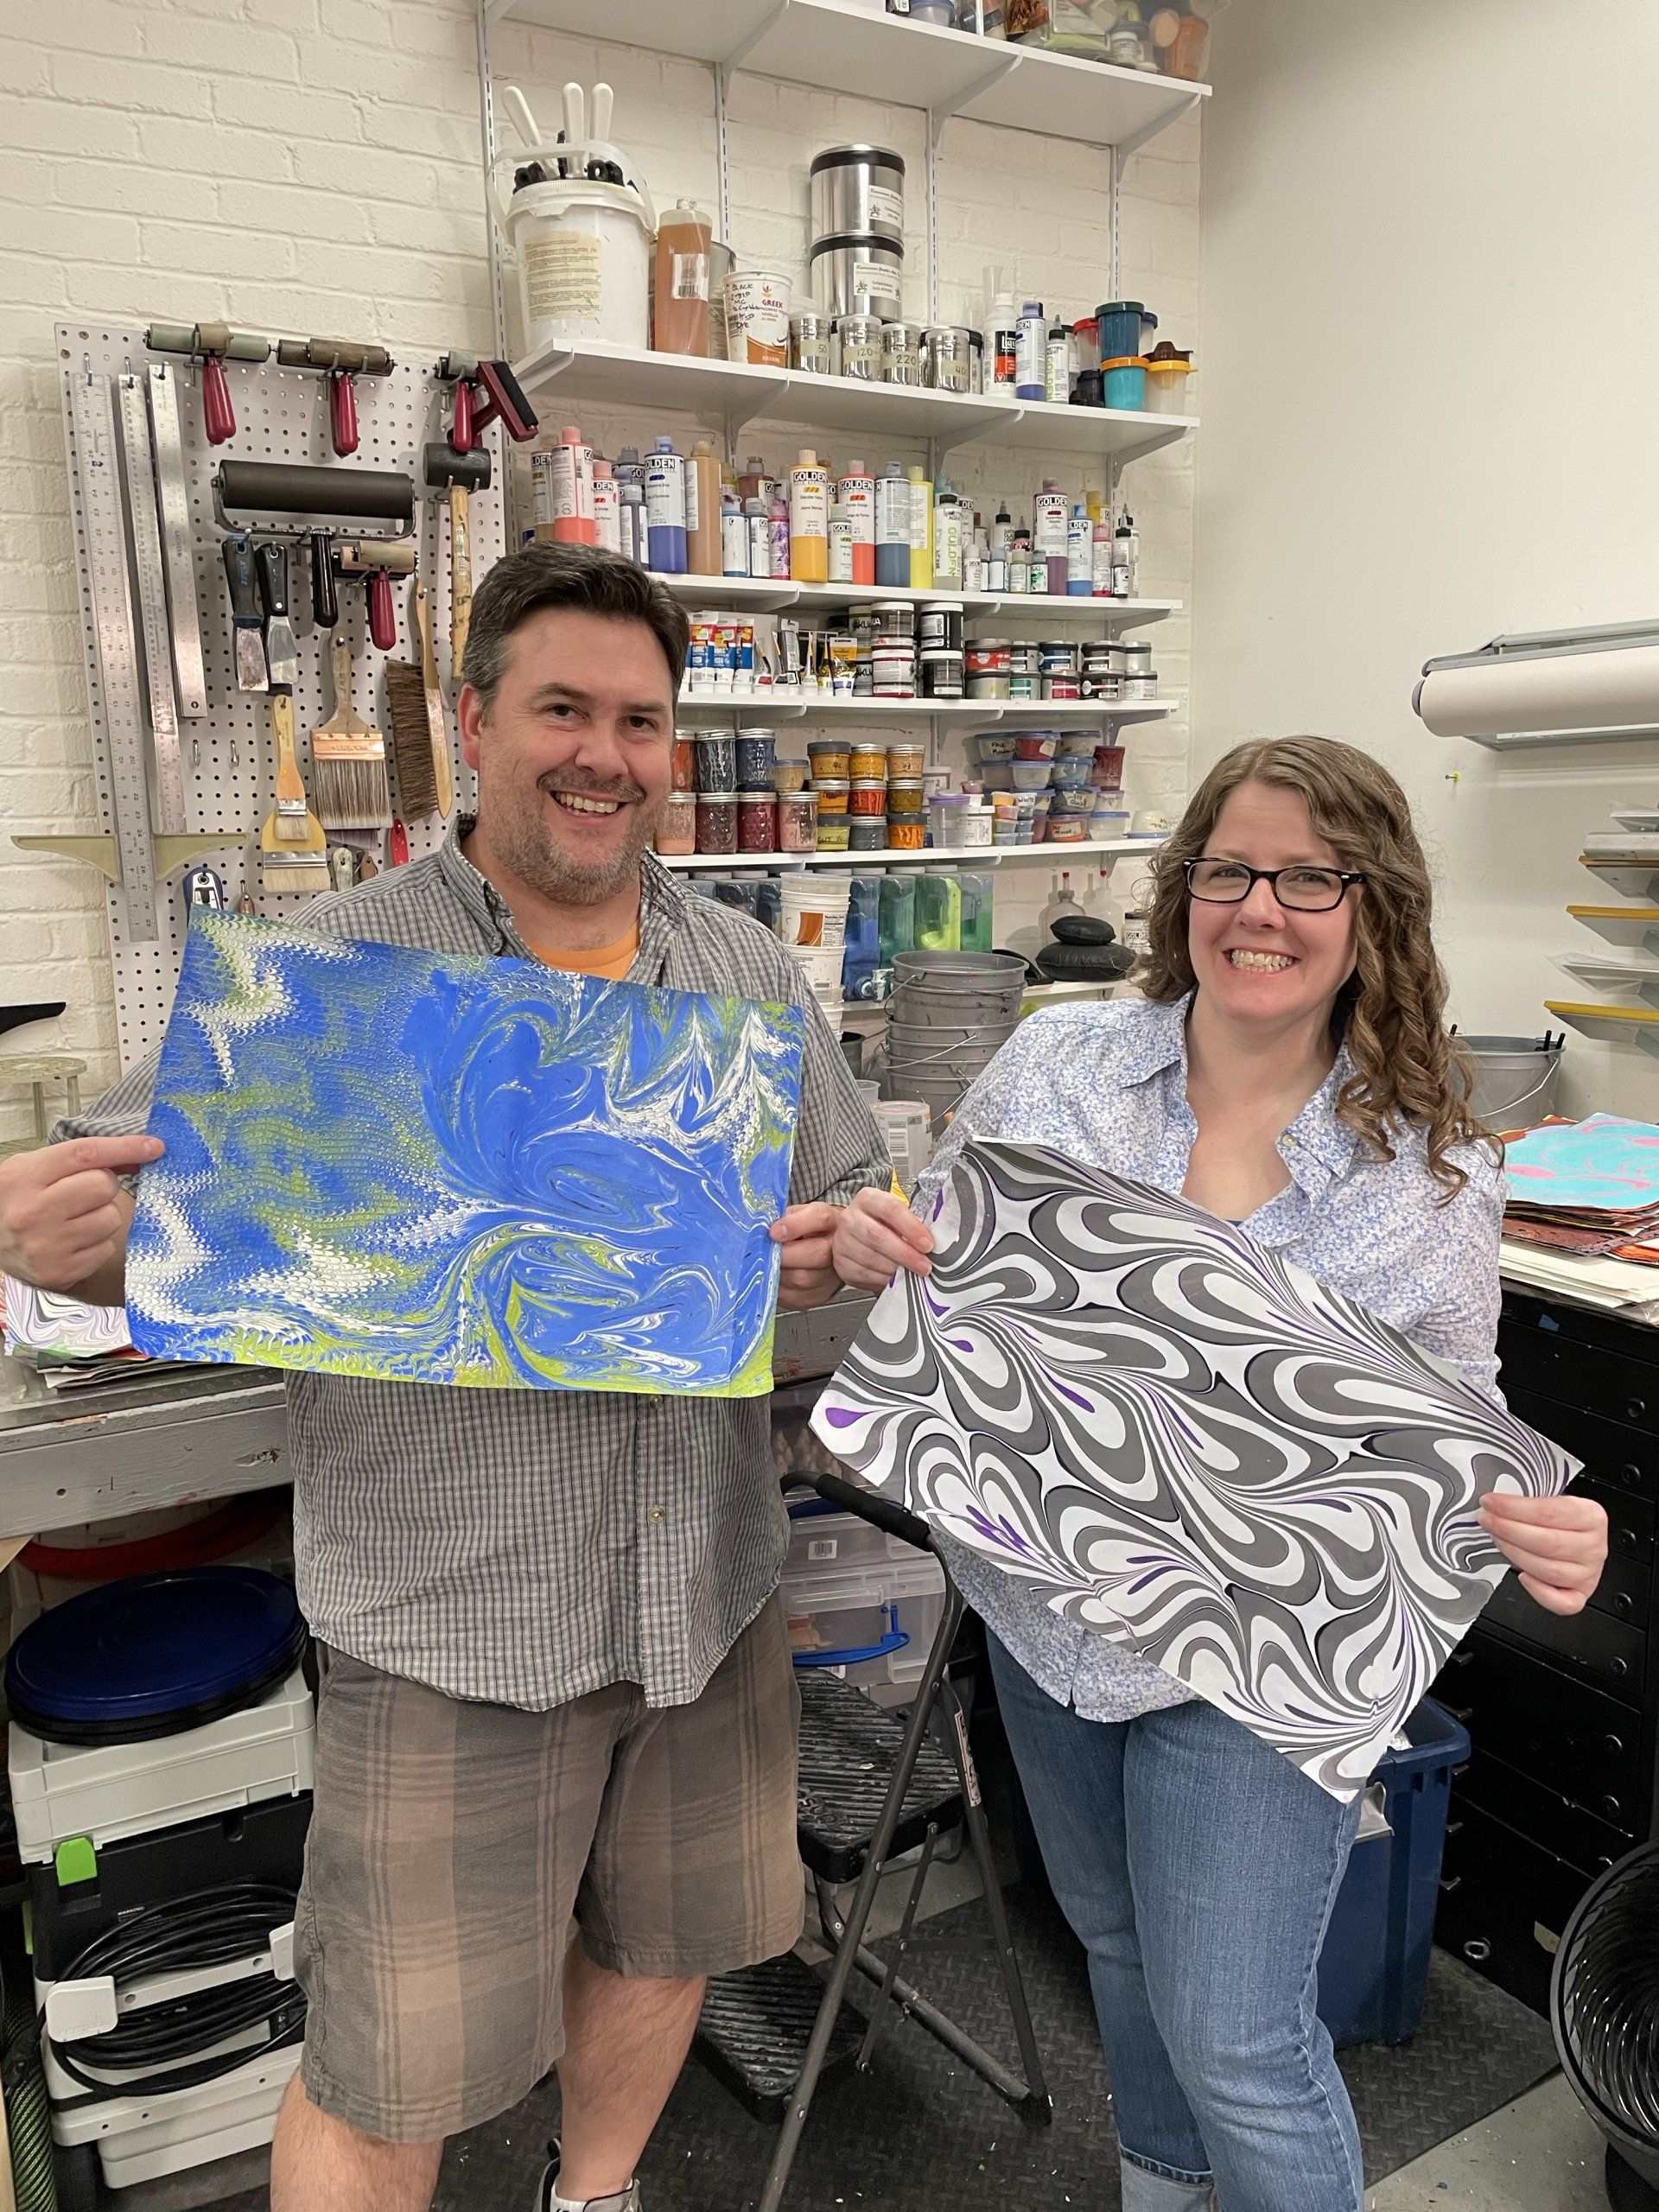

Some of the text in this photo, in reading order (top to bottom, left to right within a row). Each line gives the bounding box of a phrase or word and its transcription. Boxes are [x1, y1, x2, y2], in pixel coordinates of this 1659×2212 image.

[762, 299, 783, 308] GREEK
[818, 344, 827, 353] 50
[896, 355, 916, 365] 220
[793, 472, 827, 482] GOLDEN
[841, 480, 872, 490] GOLDEN
